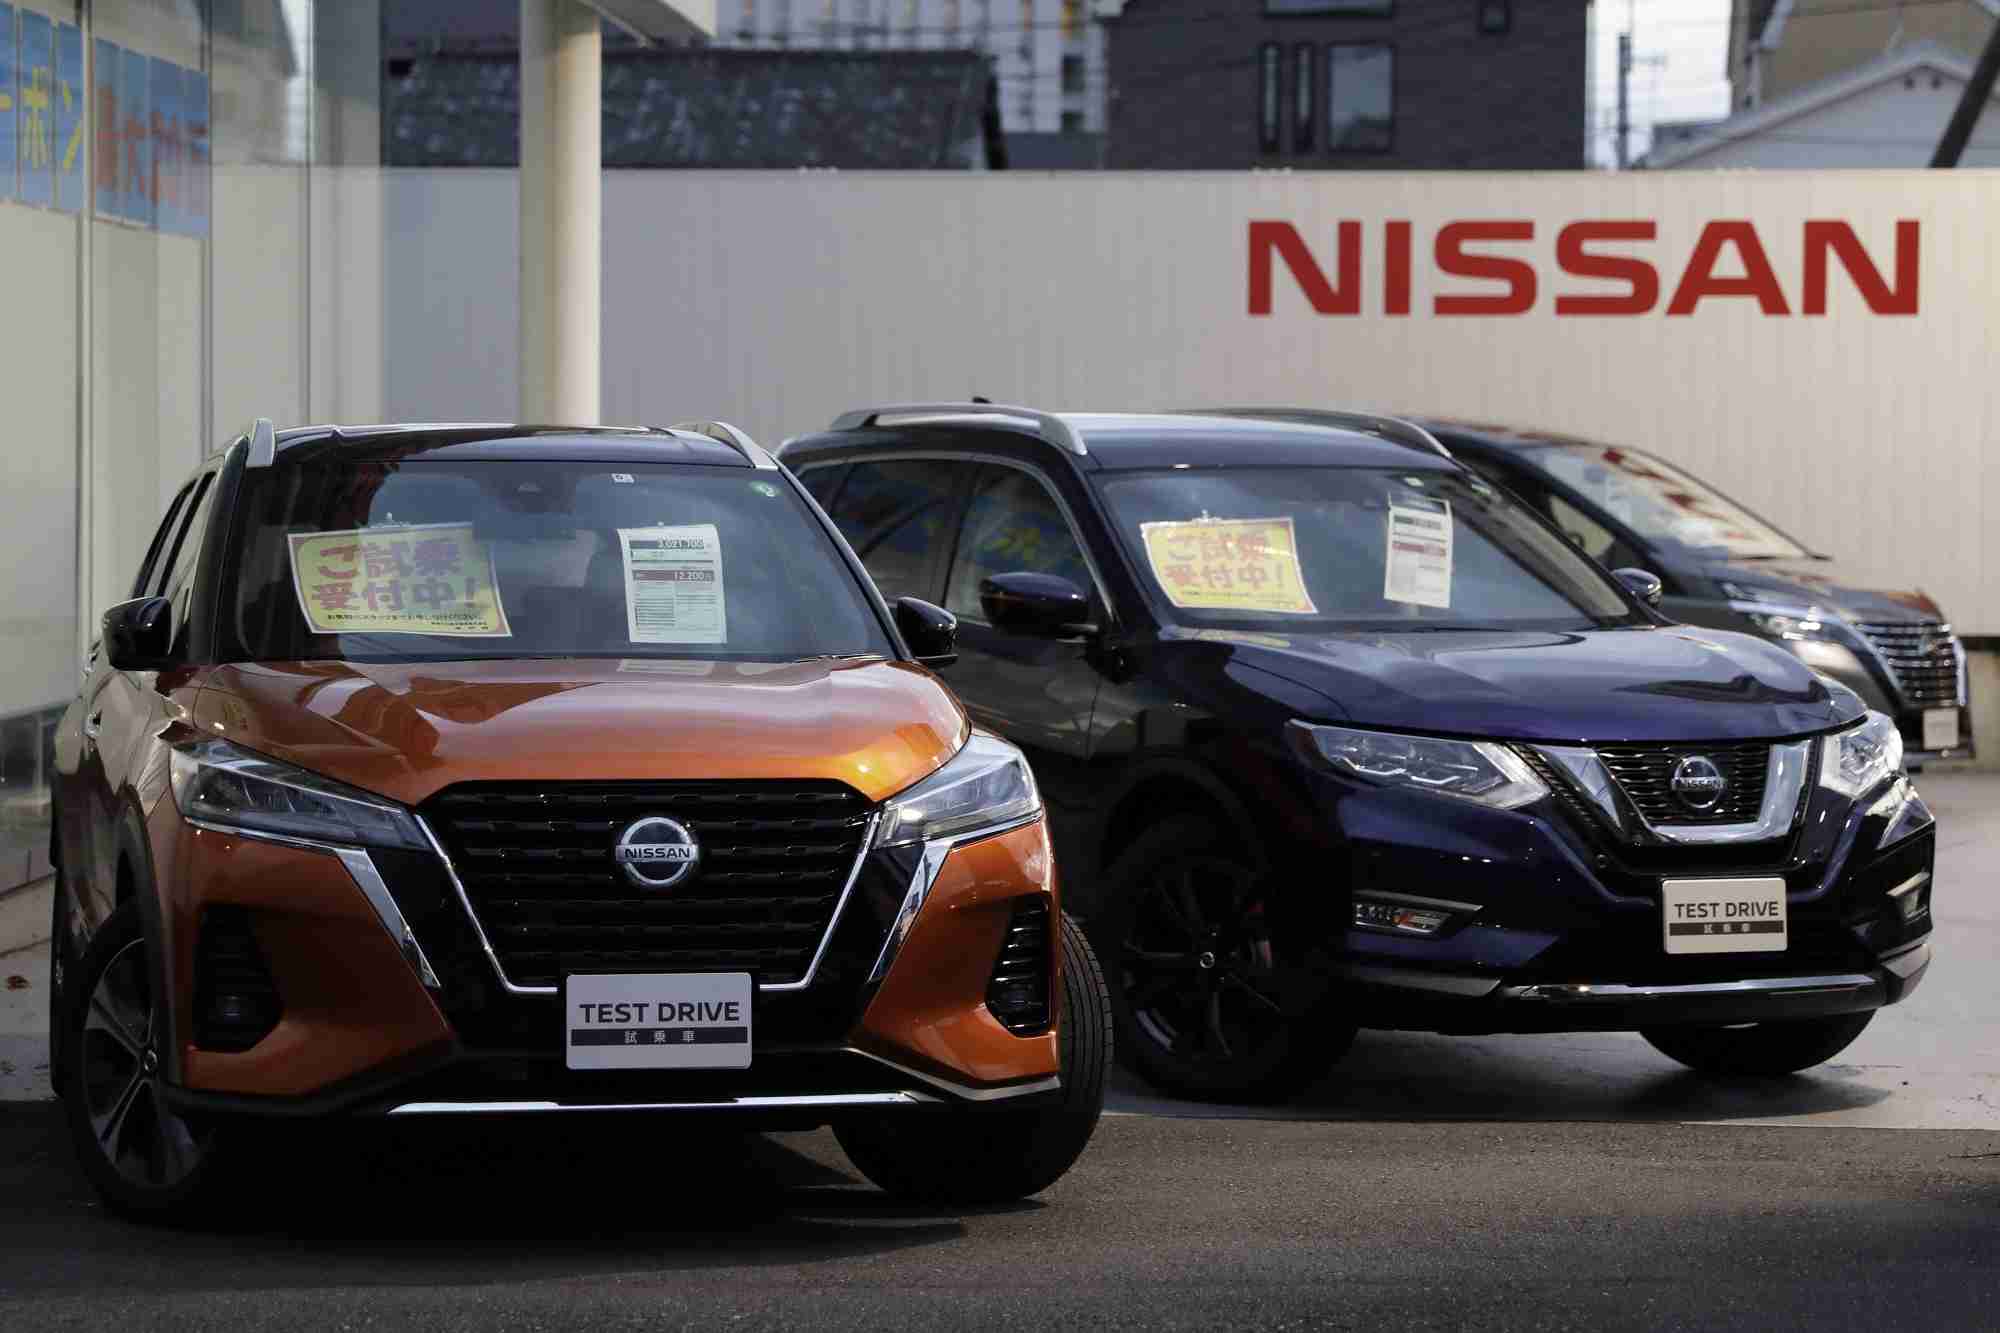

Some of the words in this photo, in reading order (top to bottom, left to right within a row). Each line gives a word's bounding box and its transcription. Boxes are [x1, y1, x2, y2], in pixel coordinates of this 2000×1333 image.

[1248, 220, 1920, 316] NISSAN
[624, 847, 690, 859] NISSAN
[1674, 903, 1721, 918] TEST
[1725, 901, 1779, 917] DRIVE
[579, 1003, 649, 1024] TEST
[657, 1001, 740, 1023] DRIVE
